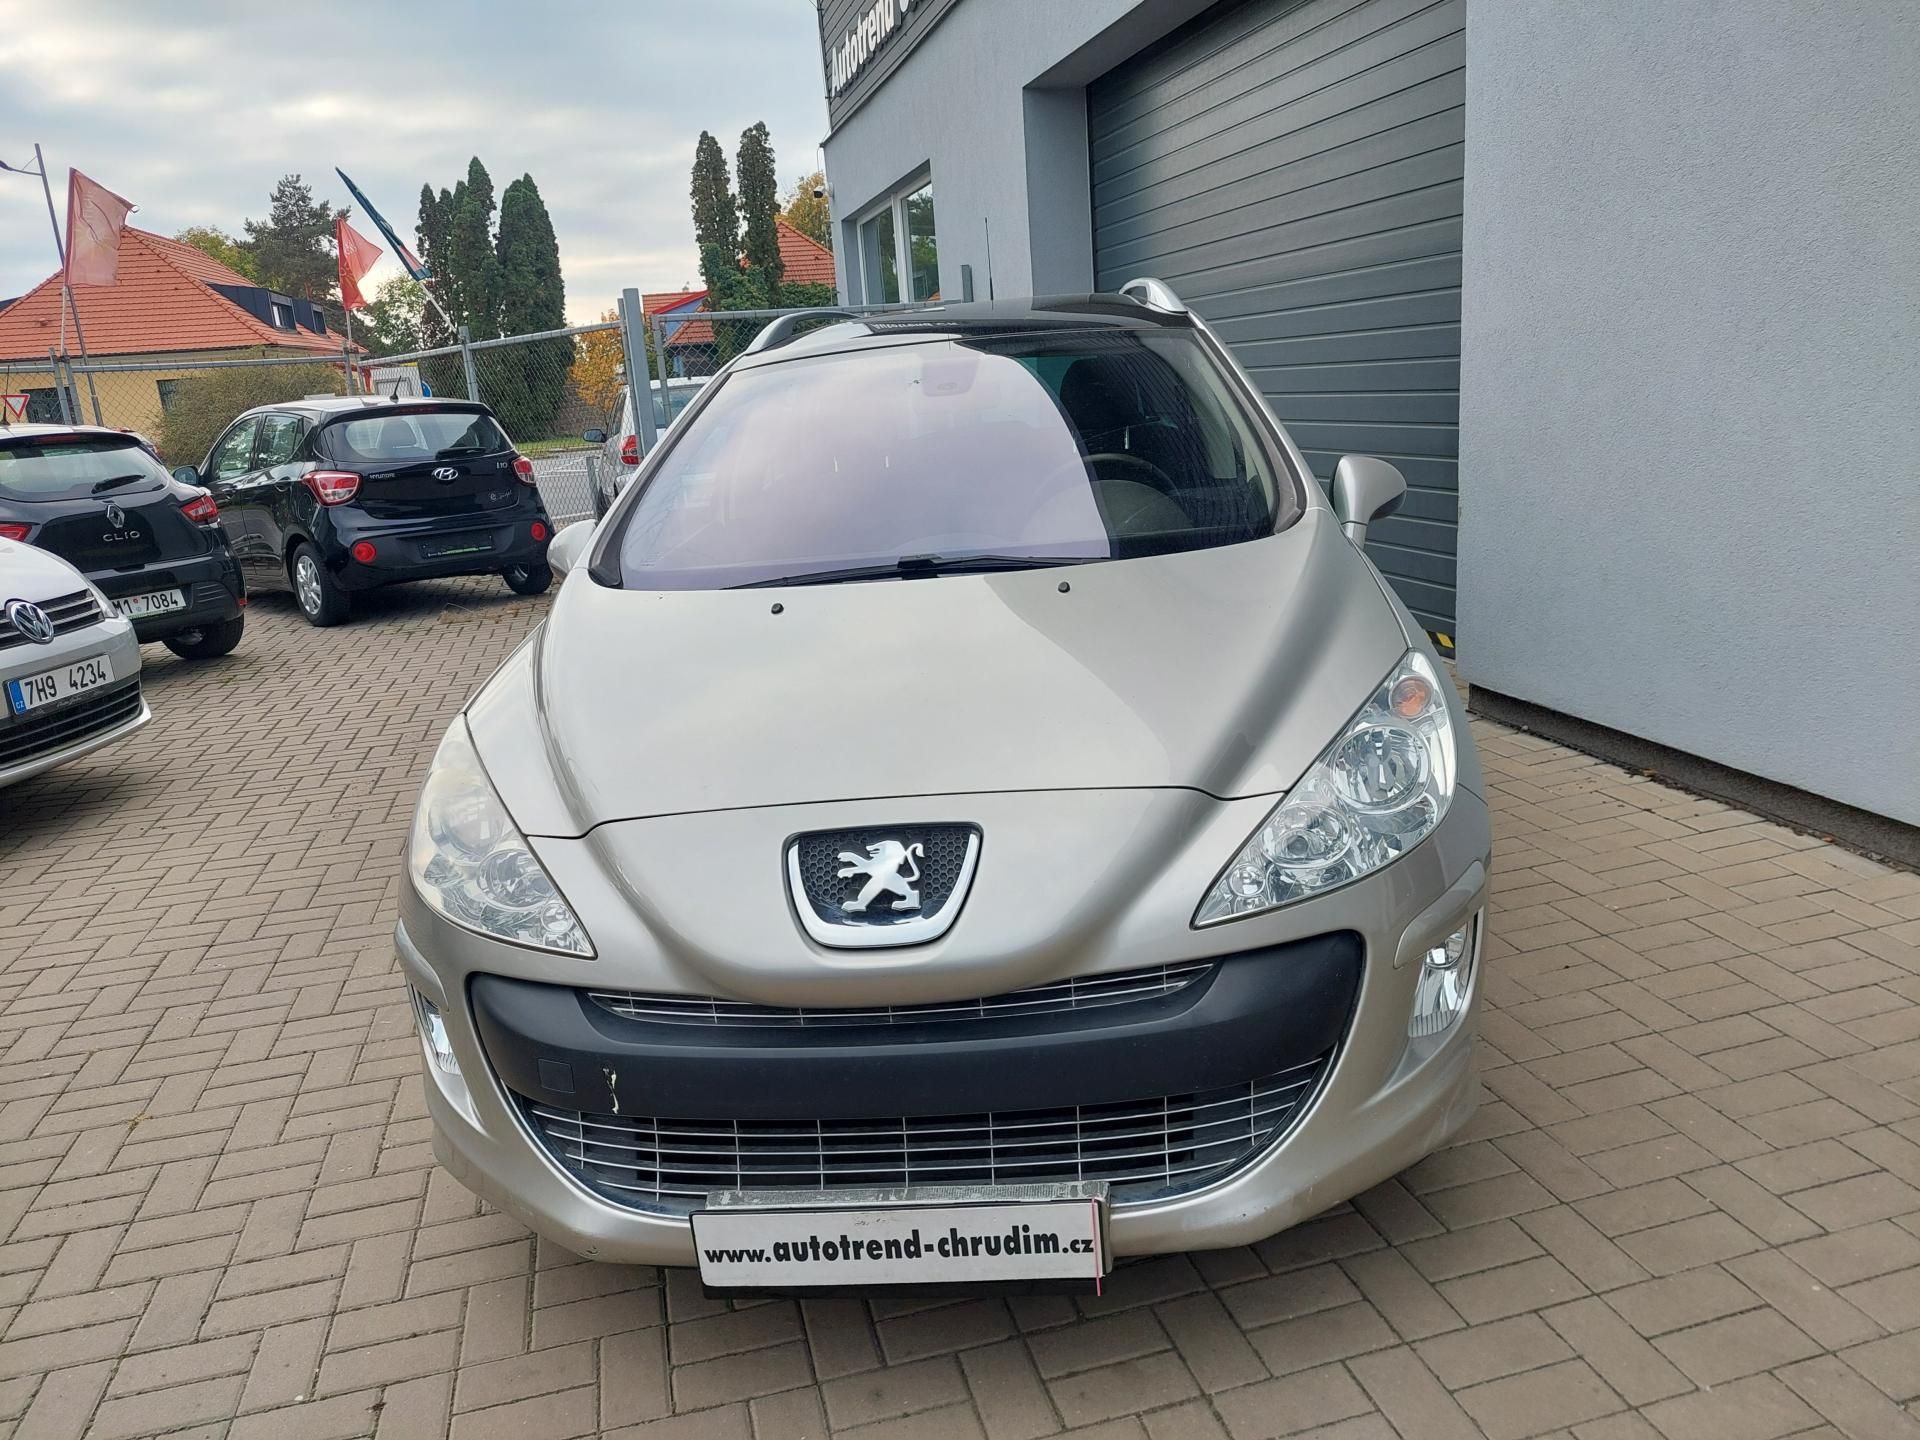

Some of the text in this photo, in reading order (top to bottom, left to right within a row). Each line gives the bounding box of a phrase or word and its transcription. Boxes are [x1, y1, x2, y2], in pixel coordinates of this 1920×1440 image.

[102, 530, 141, 542] CLIO
[112, 599, 133, 615] M1
[141, 591, 179, 612] 7084
[24, 675, 58, 706] 7H9
[69, 660, 107, 691] 4234
[15, 701, 25, 709] CZ
[704, 1224, 1094, 1263] www.autotrend-chrudim.cz
